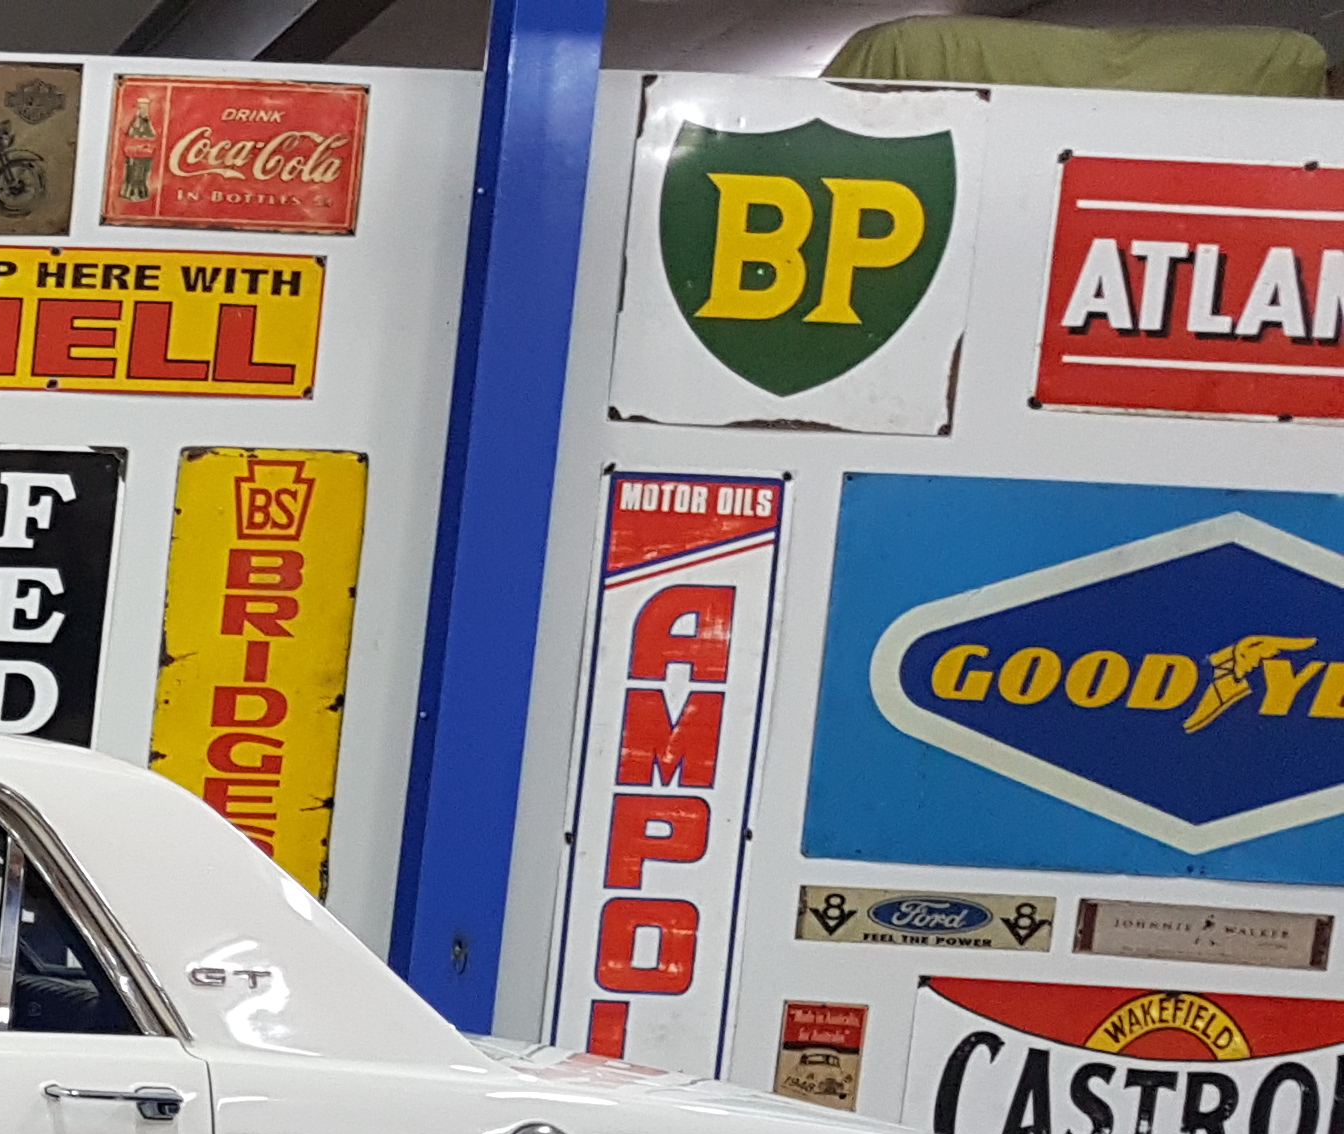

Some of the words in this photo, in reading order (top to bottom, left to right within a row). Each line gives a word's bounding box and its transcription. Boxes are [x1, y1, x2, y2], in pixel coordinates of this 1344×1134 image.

[221, 108, 286, 123] DRINK
[169, 126, 350, 184] Coca-Cola
[177, 189, 200, 201] IN
[211, 191, 302, 206] BOTTLES
[694, 172, 925, 325] BP
[36, 261, 161, 291] HERE
[181, 264, 302, 296] WITH
[245, 485, 300, 531] BS
[620, 482, 709, 514] MOTOR
[717, 486, 774, 517] OILS
[891, 900, 969, 929] Ford
[1113, 918, 1193, 932] JOHNNIE
[1224, 926, 1290, 939] WALKER
[863, 932, 895, 943] FEEL
[901, 934, 930, 945] THE
[935, 935, 992, 948] POWER
[188, 967, 271, 990] GT
[1103, 996, 1235, 1050] WAKEFIELD
